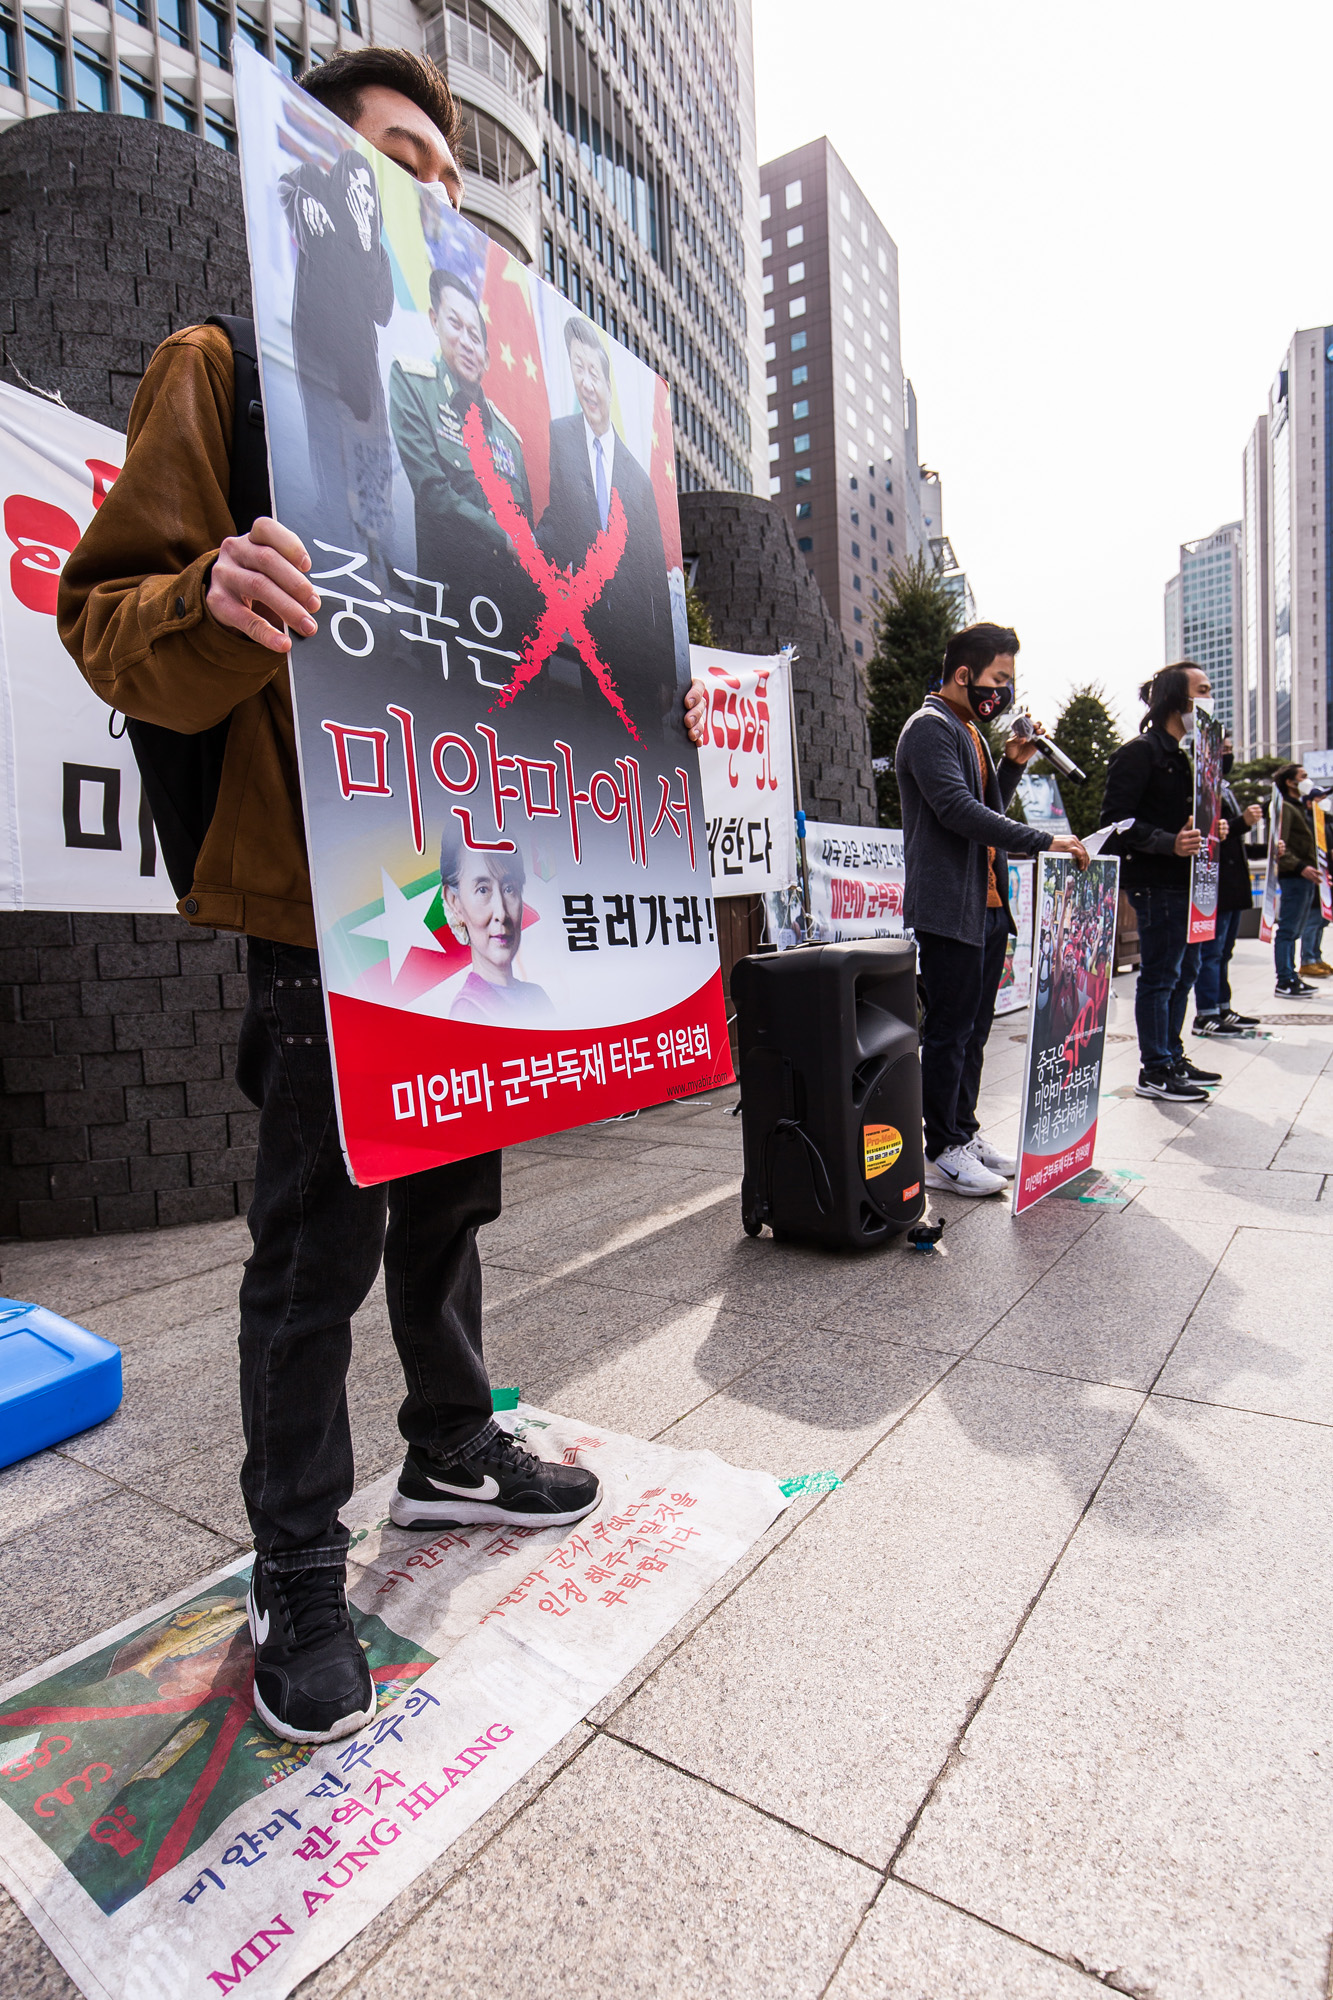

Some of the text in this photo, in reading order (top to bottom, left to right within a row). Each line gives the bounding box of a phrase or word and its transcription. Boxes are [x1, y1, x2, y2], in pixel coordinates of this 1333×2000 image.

[309, 538, 521, 693] 중국은
[320, 702, 697, 872] 미얀마에서
[842, 840, 860, 868] 같은
[562, 893, 715, 952] 물러가라!
[830, 878, 866, 919] 미얀마
[390, 1023, 713, 1128] 미얀마 군부독재 타도 위원회
[666, 1071, 728, 1097] www.myabiz.com
[1034, 1060, 1100, 1116] 미얀마 군부독재
[1036, 1043, 1066, 1083] 중국은
[1029, 1094, 1089, 1149] 지원 중단하라
[1025, 1168, 1043, 1193] 미얀마
[1043, 1156, 1064, 1184] 군부독재
[1064, 1151, 1075, 1170] 타도
[375, 1532, 471, 1595] 미얀마
[597, 1526, 702, 1608] 부탁합니다
[178, 1687, 441, 1905] 미얀마 민주주의
[292, 1768, 407, 1861] 반역자
[206, 1722, 515, 1997] MIN AUNG HLAING
